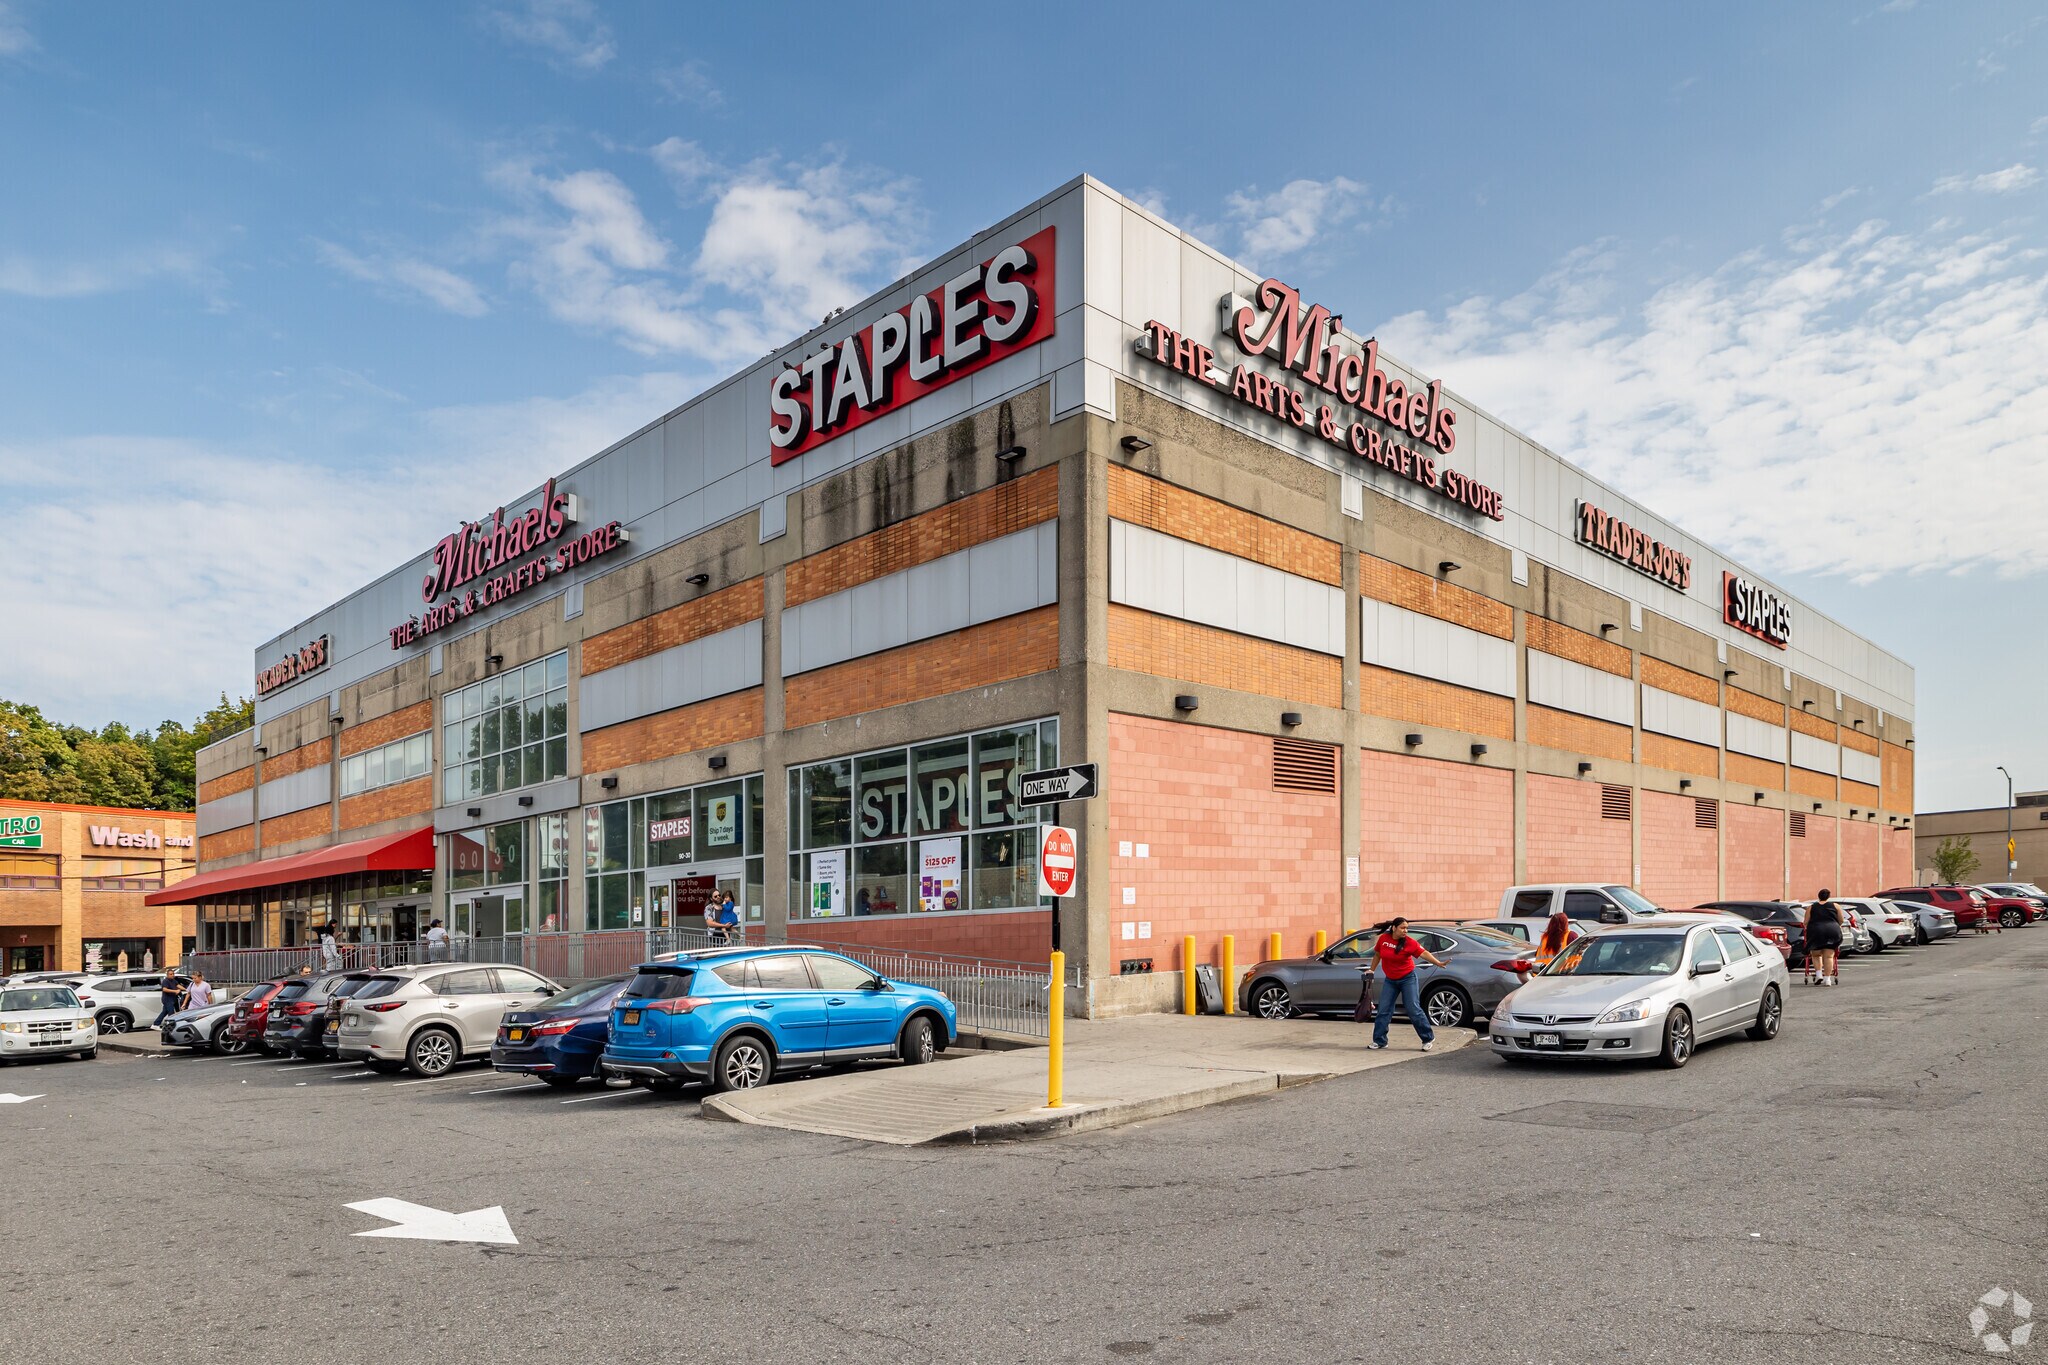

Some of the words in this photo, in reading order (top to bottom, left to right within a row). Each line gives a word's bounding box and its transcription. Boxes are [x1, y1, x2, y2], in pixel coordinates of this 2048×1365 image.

[769, 245, 1031, 448] STAPLES
[1233, 278, 1457, 454] Michaels
[1146, 319, 1216, 386] THE
[1231, 364, 1306, 427] ARTS
[1317, 405, 1339, 443] &
[1348, 422, 1437, 488] CRAFTS
[1444, 469, 1505, 522] STORE
[422, 478, 568, 603] Michaels
[1582, 502, 1655, 572] TRADER
[1652, 541, 1693, 589] JOE'S
[389, 620, 415, 650] THE
[419, 598, 457, 637] ARTS
[463, 591, 475, 616] &
[482, 555, 548, 606] CRAFTS
[555, 521, 619, 573] STORE
[1734, 577, 1792, 643] STAPLES
[257, 656, 297, 695] TRADER
[1026, 781, 1045, 796] ONE
[1048, 777, 1069, 793] WAY
[89, 825, 160, 848] Wash
[165, 835, 194, 847] and
[651, 819, 690, 839] STAPLES
[709, 827, 719, 835] Ship
[723, 826, 734, 834] days
[678, 852, 691, 860] 90-30
[925, 858, 940, 866] $125
[941, 856, 956, 865] OFF
[1048, 841, 1057, 851] DO
[1060, 843, 1071, 853] NOT
[1052, 870, 1069, 882] ENTER
